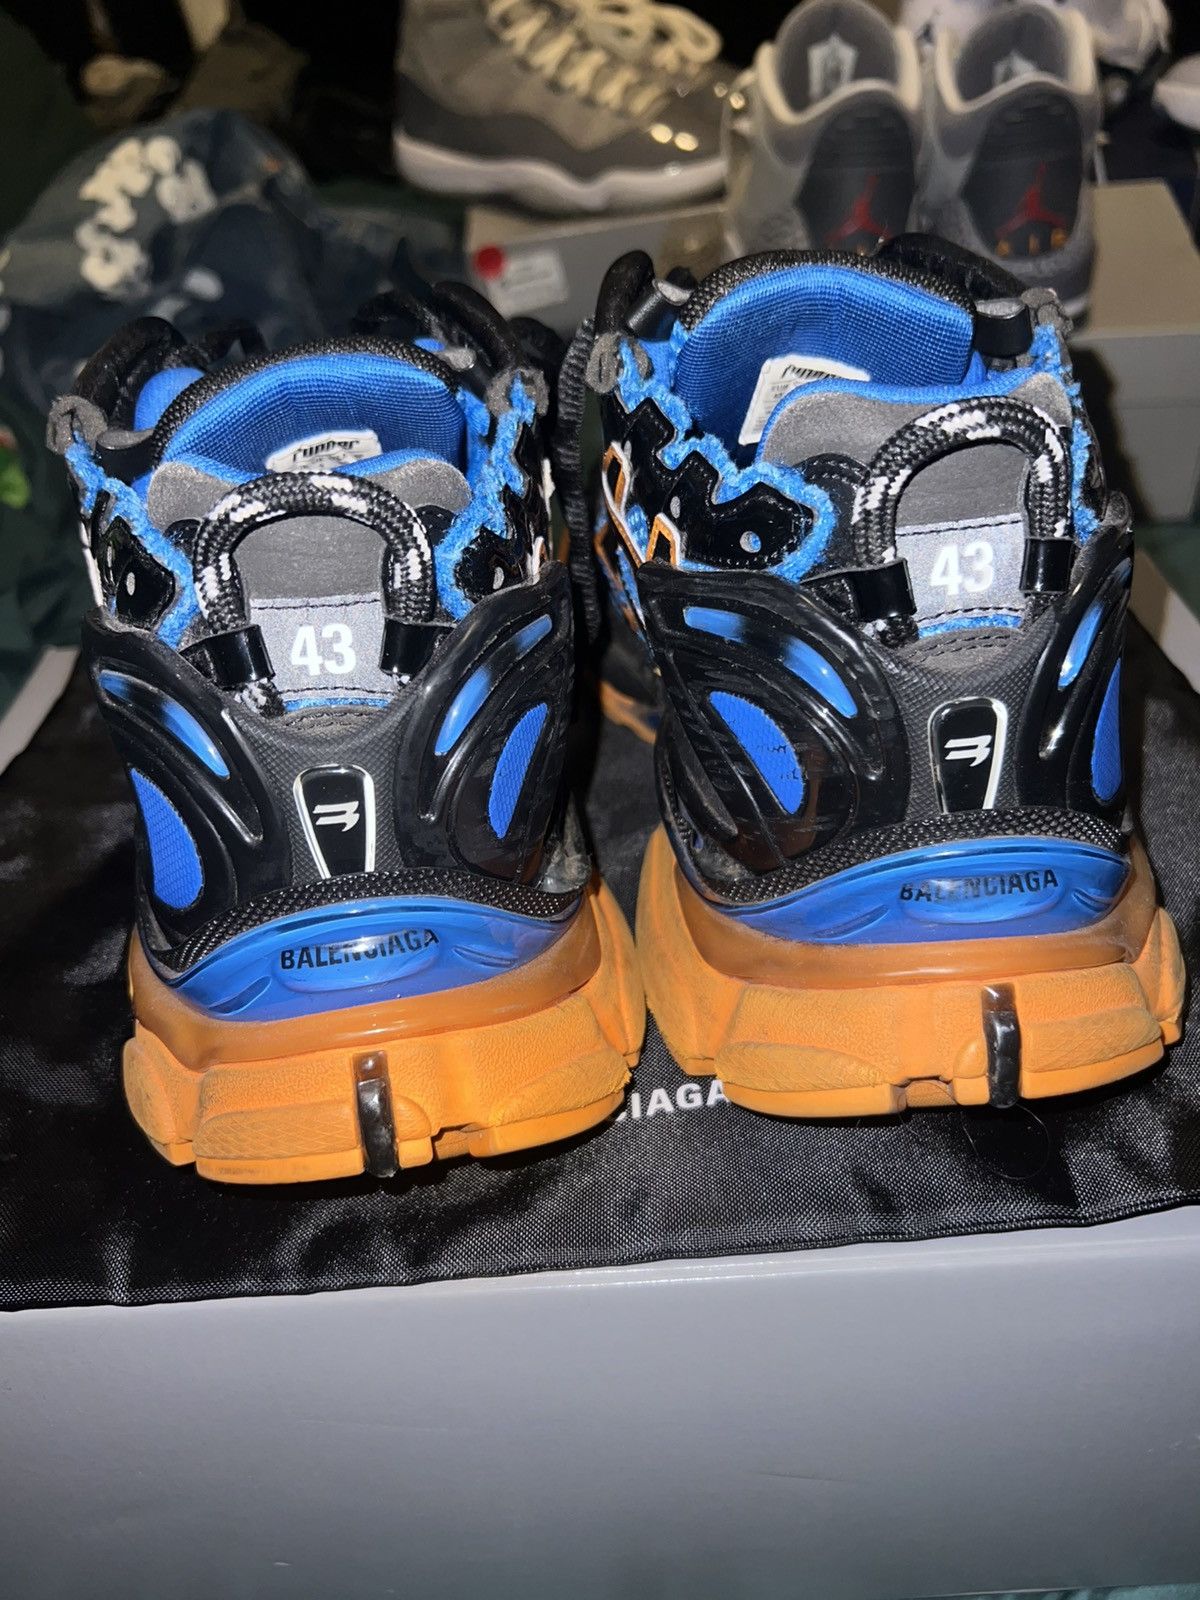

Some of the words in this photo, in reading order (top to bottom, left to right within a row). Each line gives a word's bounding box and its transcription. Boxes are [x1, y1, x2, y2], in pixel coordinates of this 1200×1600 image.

[930, 541, 994, 596] 43
[290, 623, 357, 676] 43
[616, 1079, 731, 1122] IAGA
